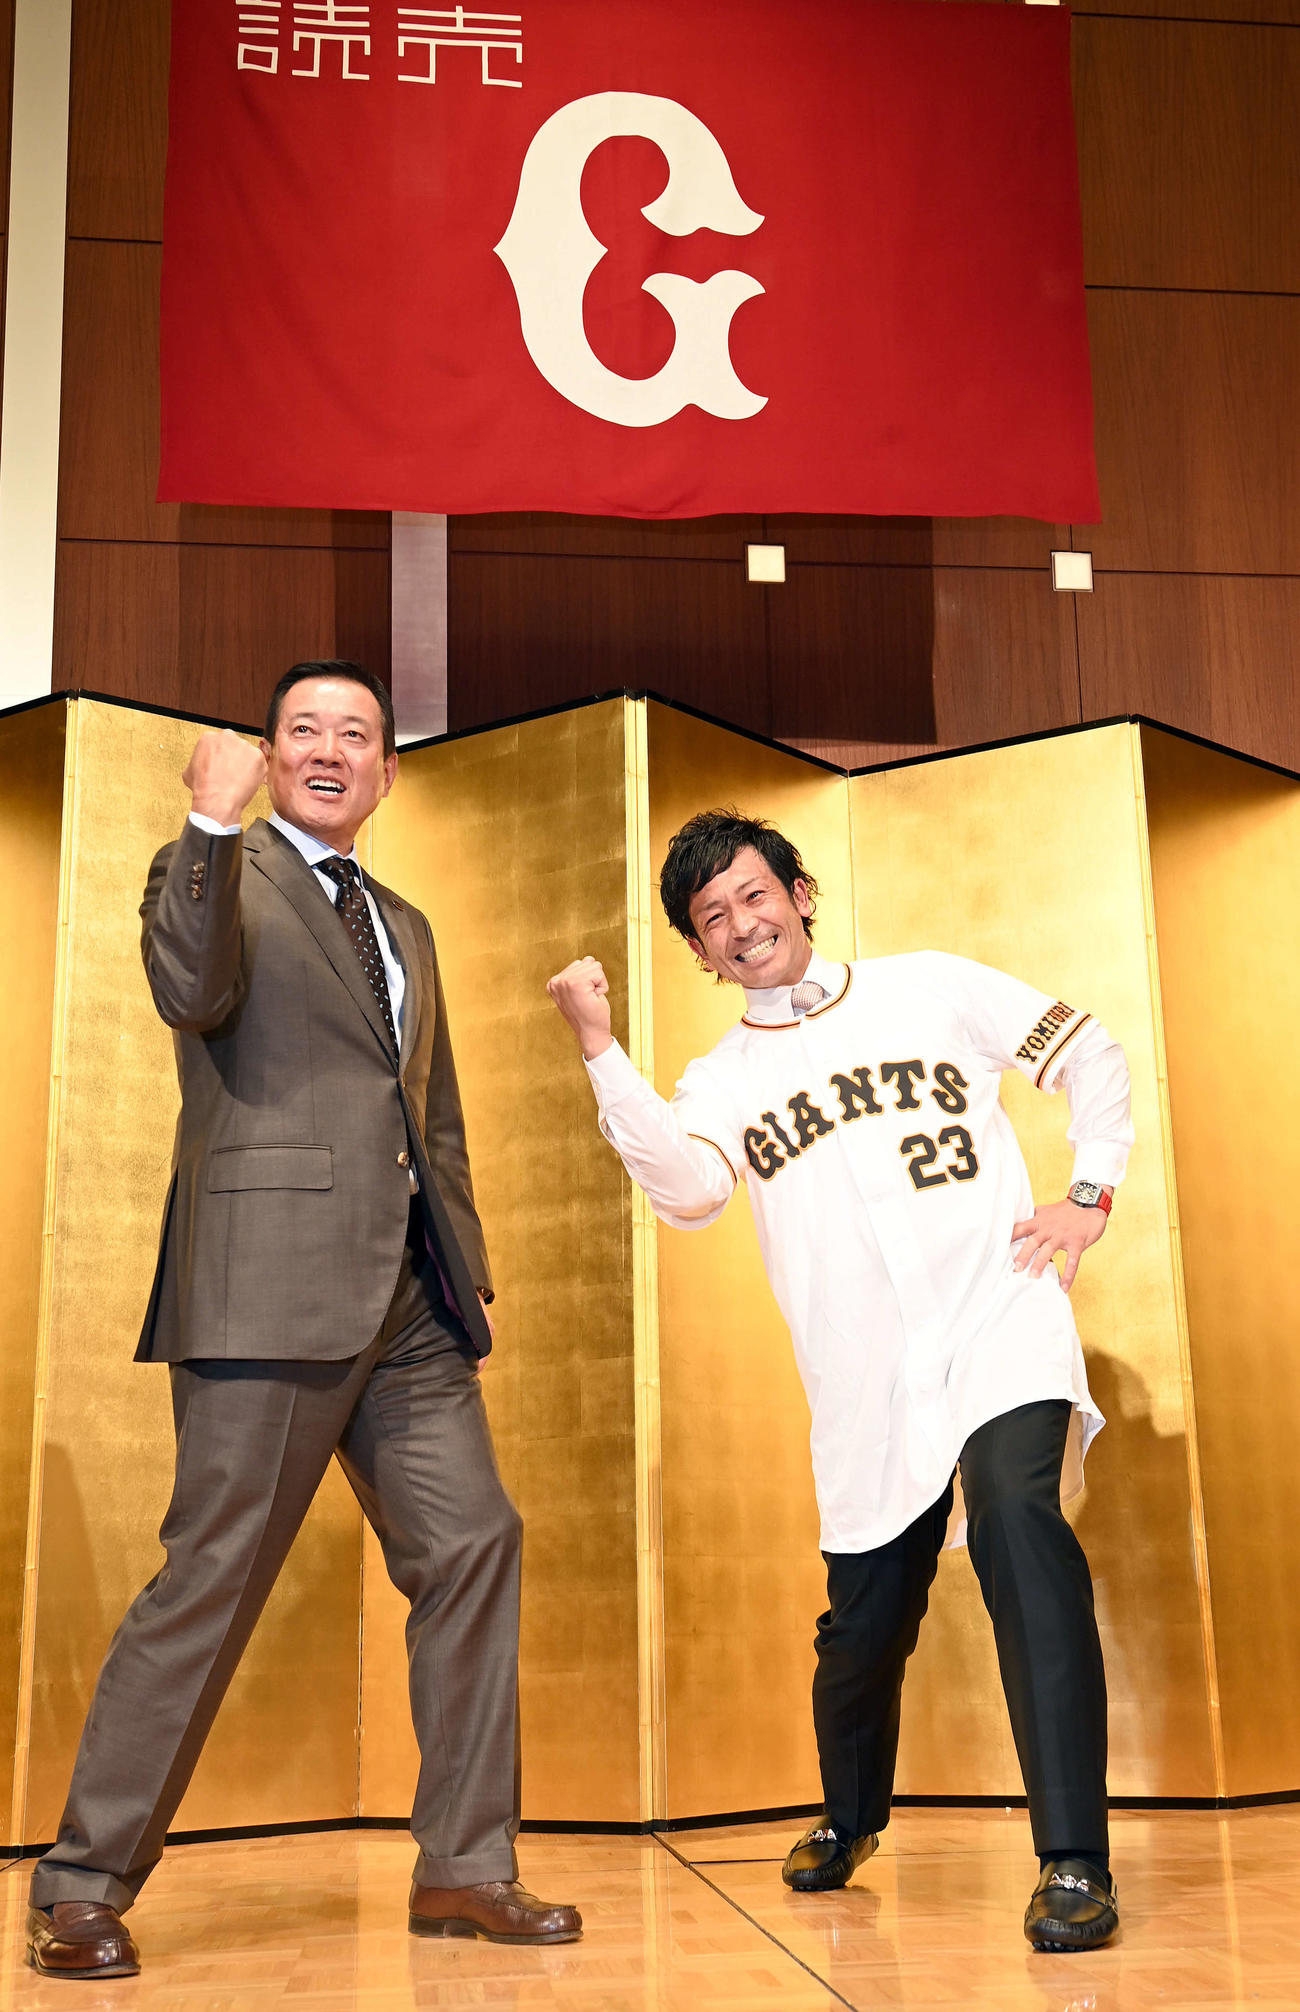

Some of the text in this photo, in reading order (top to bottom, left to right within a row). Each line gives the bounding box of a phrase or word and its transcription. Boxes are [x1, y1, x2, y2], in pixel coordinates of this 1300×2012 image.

[494, 91, 768, 427] G
[1015, 1000, 1076, 1063] YOMIURI
[744, 1059, 970, 1182] GIANTS
[900, 1125, 981, 1192] 23
